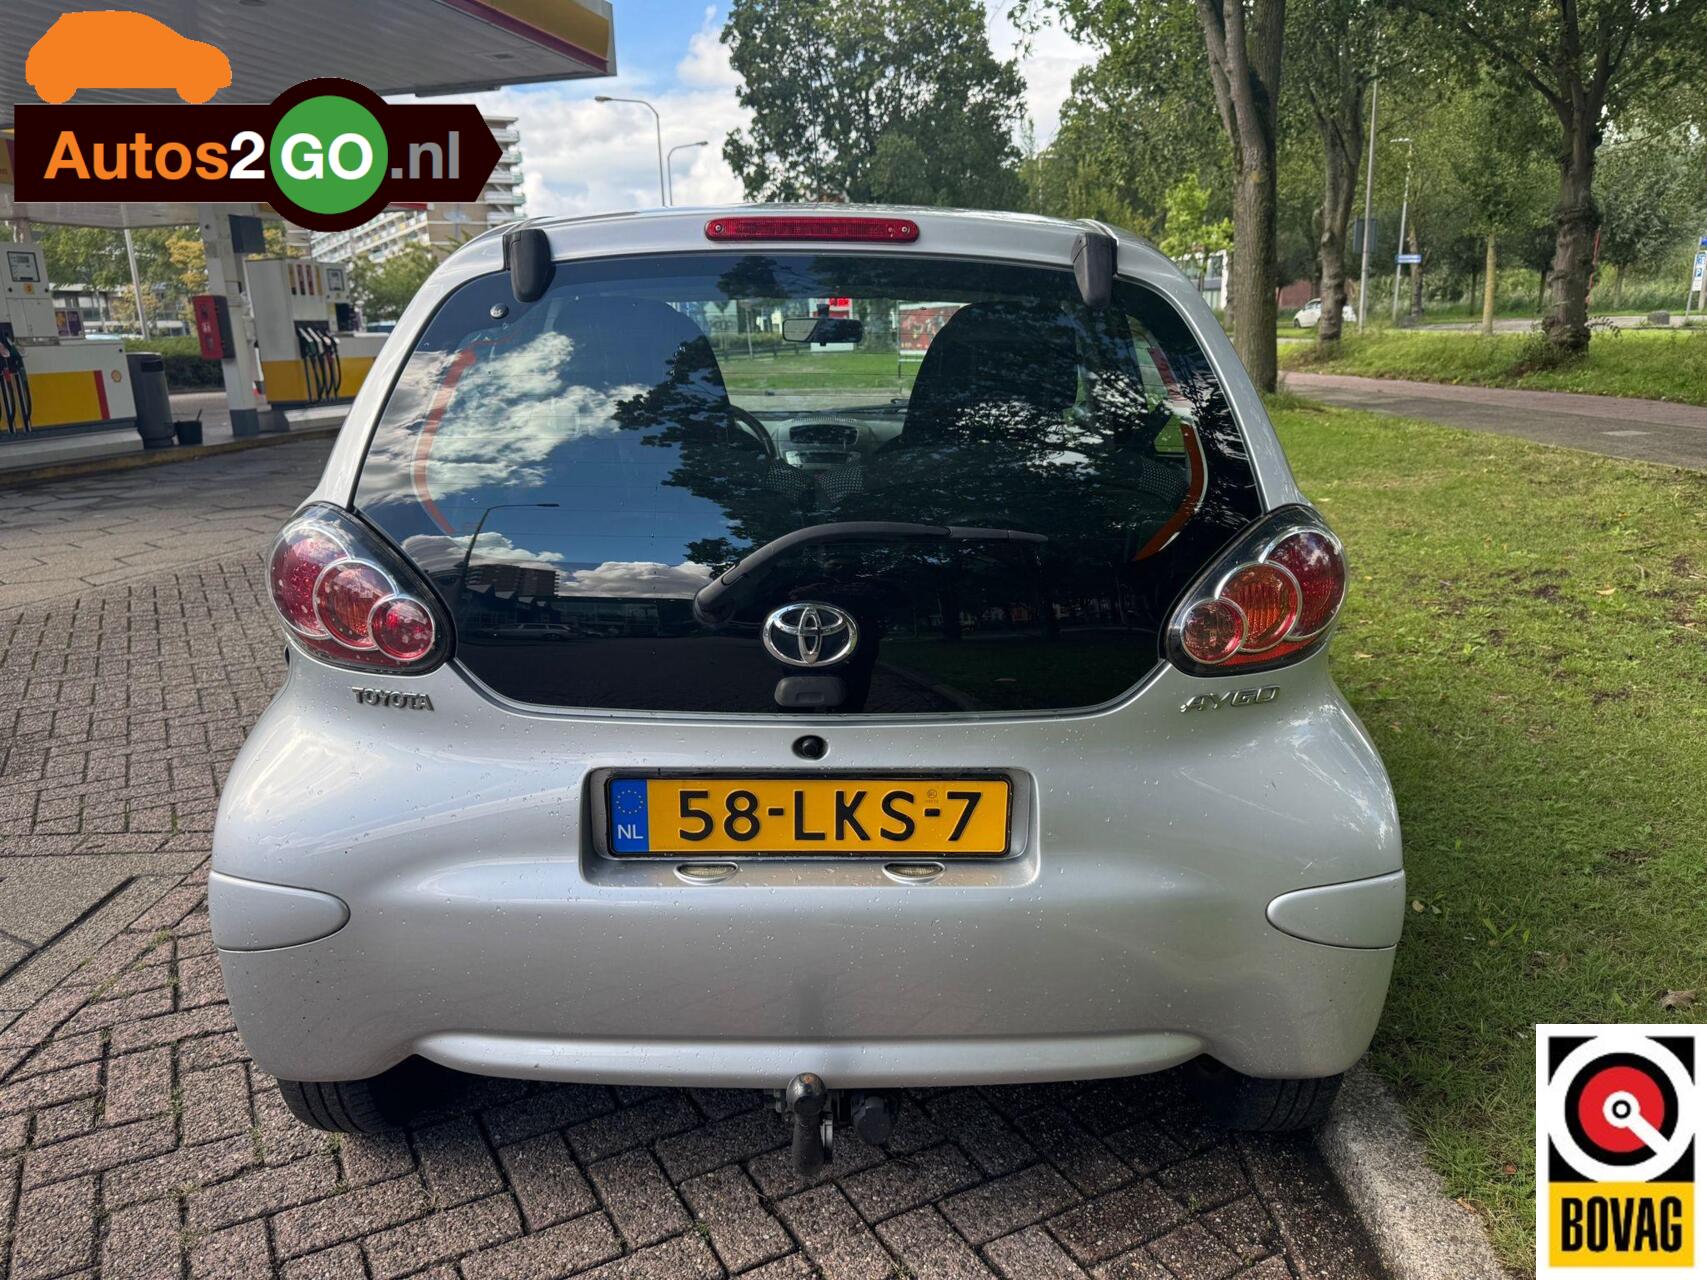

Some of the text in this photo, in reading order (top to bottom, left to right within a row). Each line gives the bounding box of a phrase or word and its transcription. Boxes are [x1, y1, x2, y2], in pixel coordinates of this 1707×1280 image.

[351, 686, 434, 712] TOYOTA
[1180, 685, 1280, 713] AYGO
[679, 790, 982, 842] 58-LKS-7
[617, 824, 644, 840] NL
